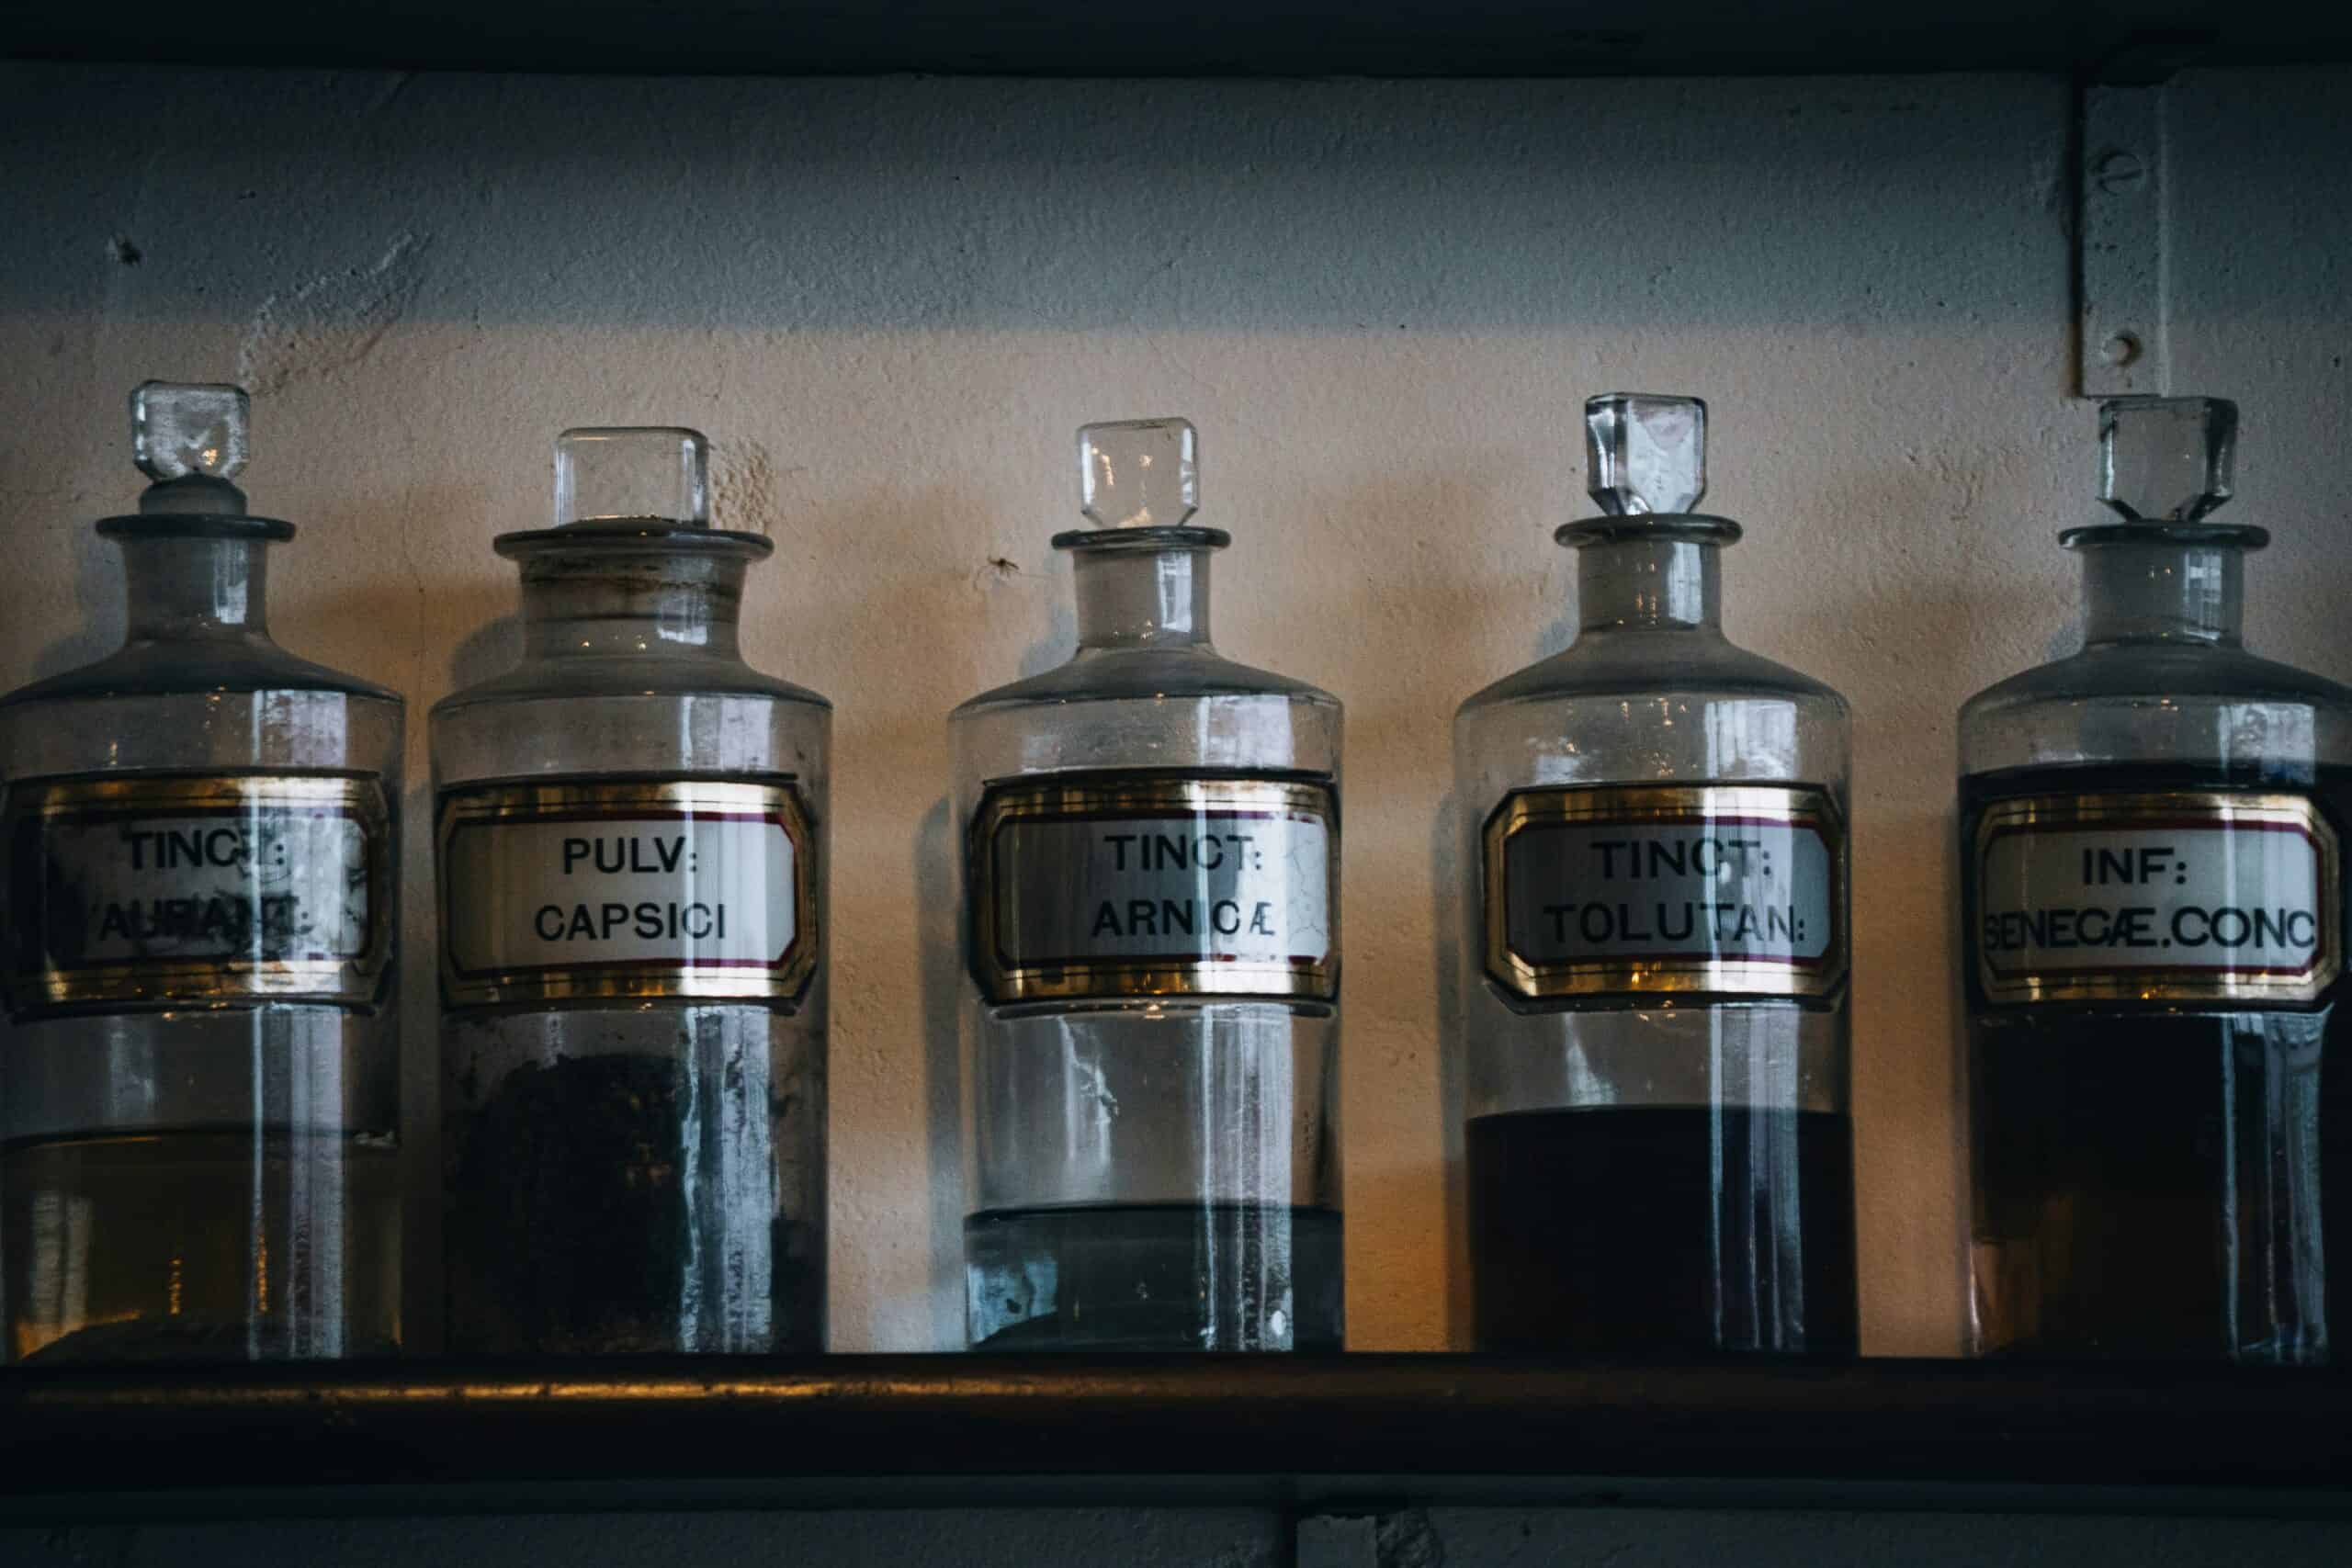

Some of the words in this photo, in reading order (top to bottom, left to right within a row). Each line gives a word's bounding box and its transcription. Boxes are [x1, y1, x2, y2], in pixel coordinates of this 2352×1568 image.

[564, 837, 697, 874] PULV:
[1104, 835, 1261, 871] TINCT:
[1591, 838, 1770, 878] TINCT:
[2083, 847, 2187, 885] INF:
[535, 903, 725, 942] CAPSICI
[1091, 899, 1275, 937] ARNCÆ
[1544, 901, 1804, 943] TOLUTAN:
